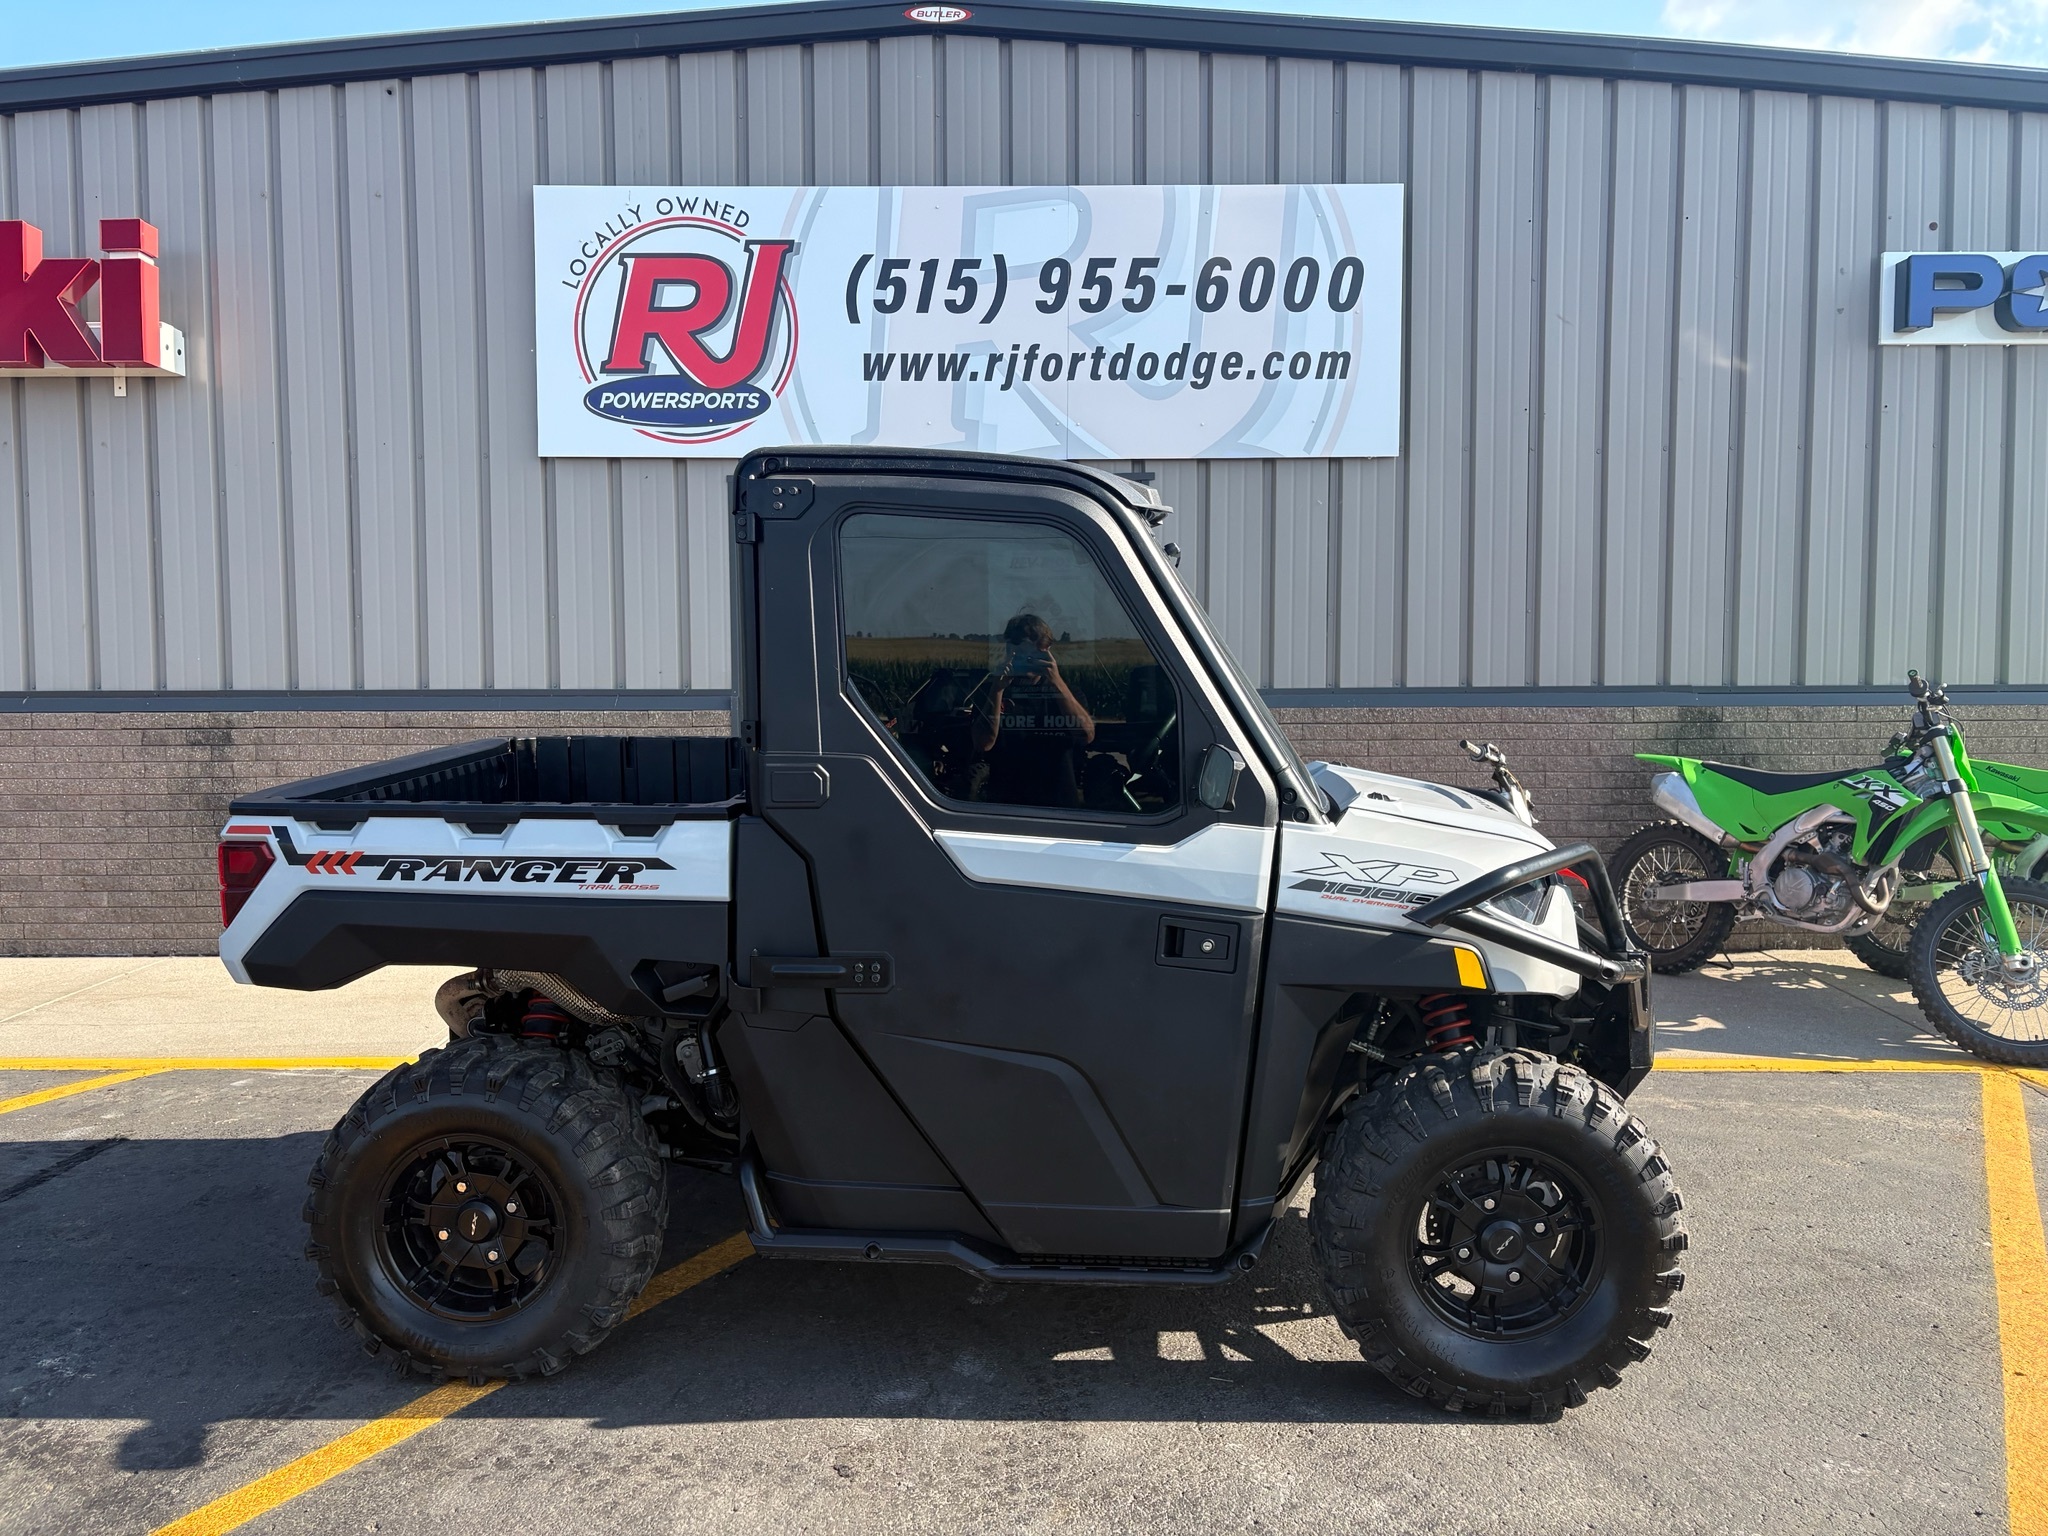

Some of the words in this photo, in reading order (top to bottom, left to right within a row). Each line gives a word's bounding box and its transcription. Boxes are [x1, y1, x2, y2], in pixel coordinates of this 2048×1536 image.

[916, 10, 962, 18] BUTLER
[562, 204, 643, 290] LOCALLY
[656, 196, 750, 229] OWNED
[845, 254, 1009, 324] (515)
[1034, 256, 1366, 314] 955-6000
[599, 239, 801, 390] RJ
[862, 342, 1352, 391] www.rjfortdodge.com
[599, 392, 760, 410] POWERSPORTS
[1043, 714, 1094, 728] HOUR
[1985, 765, 2021, 782] Kawasaki
[1852, 775, 1904, 800] KX
[1872, 800, 1897, 812] 450
[376, 859, 646, 884] RANGER
[1291, 852, 1460, 887] XP
[1320, 894, 1350, 902] DUAL
[1352, 897, 1410, 911] OVERHEAD
[1321, 881, 1440, 906] 1000
